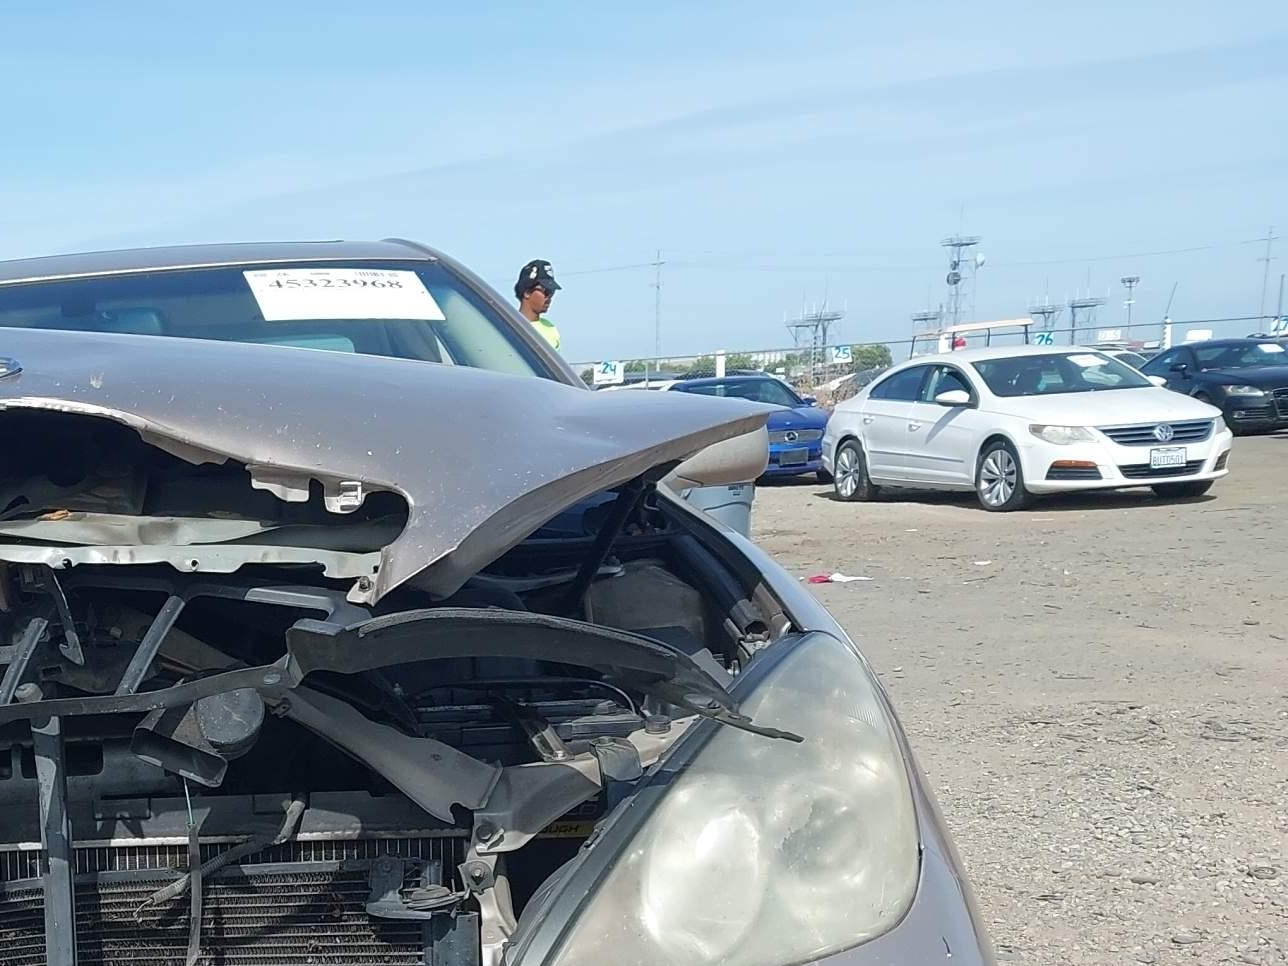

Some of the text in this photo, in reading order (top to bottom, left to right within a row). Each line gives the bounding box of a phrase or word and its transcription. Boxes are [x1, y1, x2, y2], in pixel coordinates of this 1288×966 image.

[268, 278, 404, 289] 45323968
[834, 346, 850, 359] 25
[601, 362, 617, 376] 24
